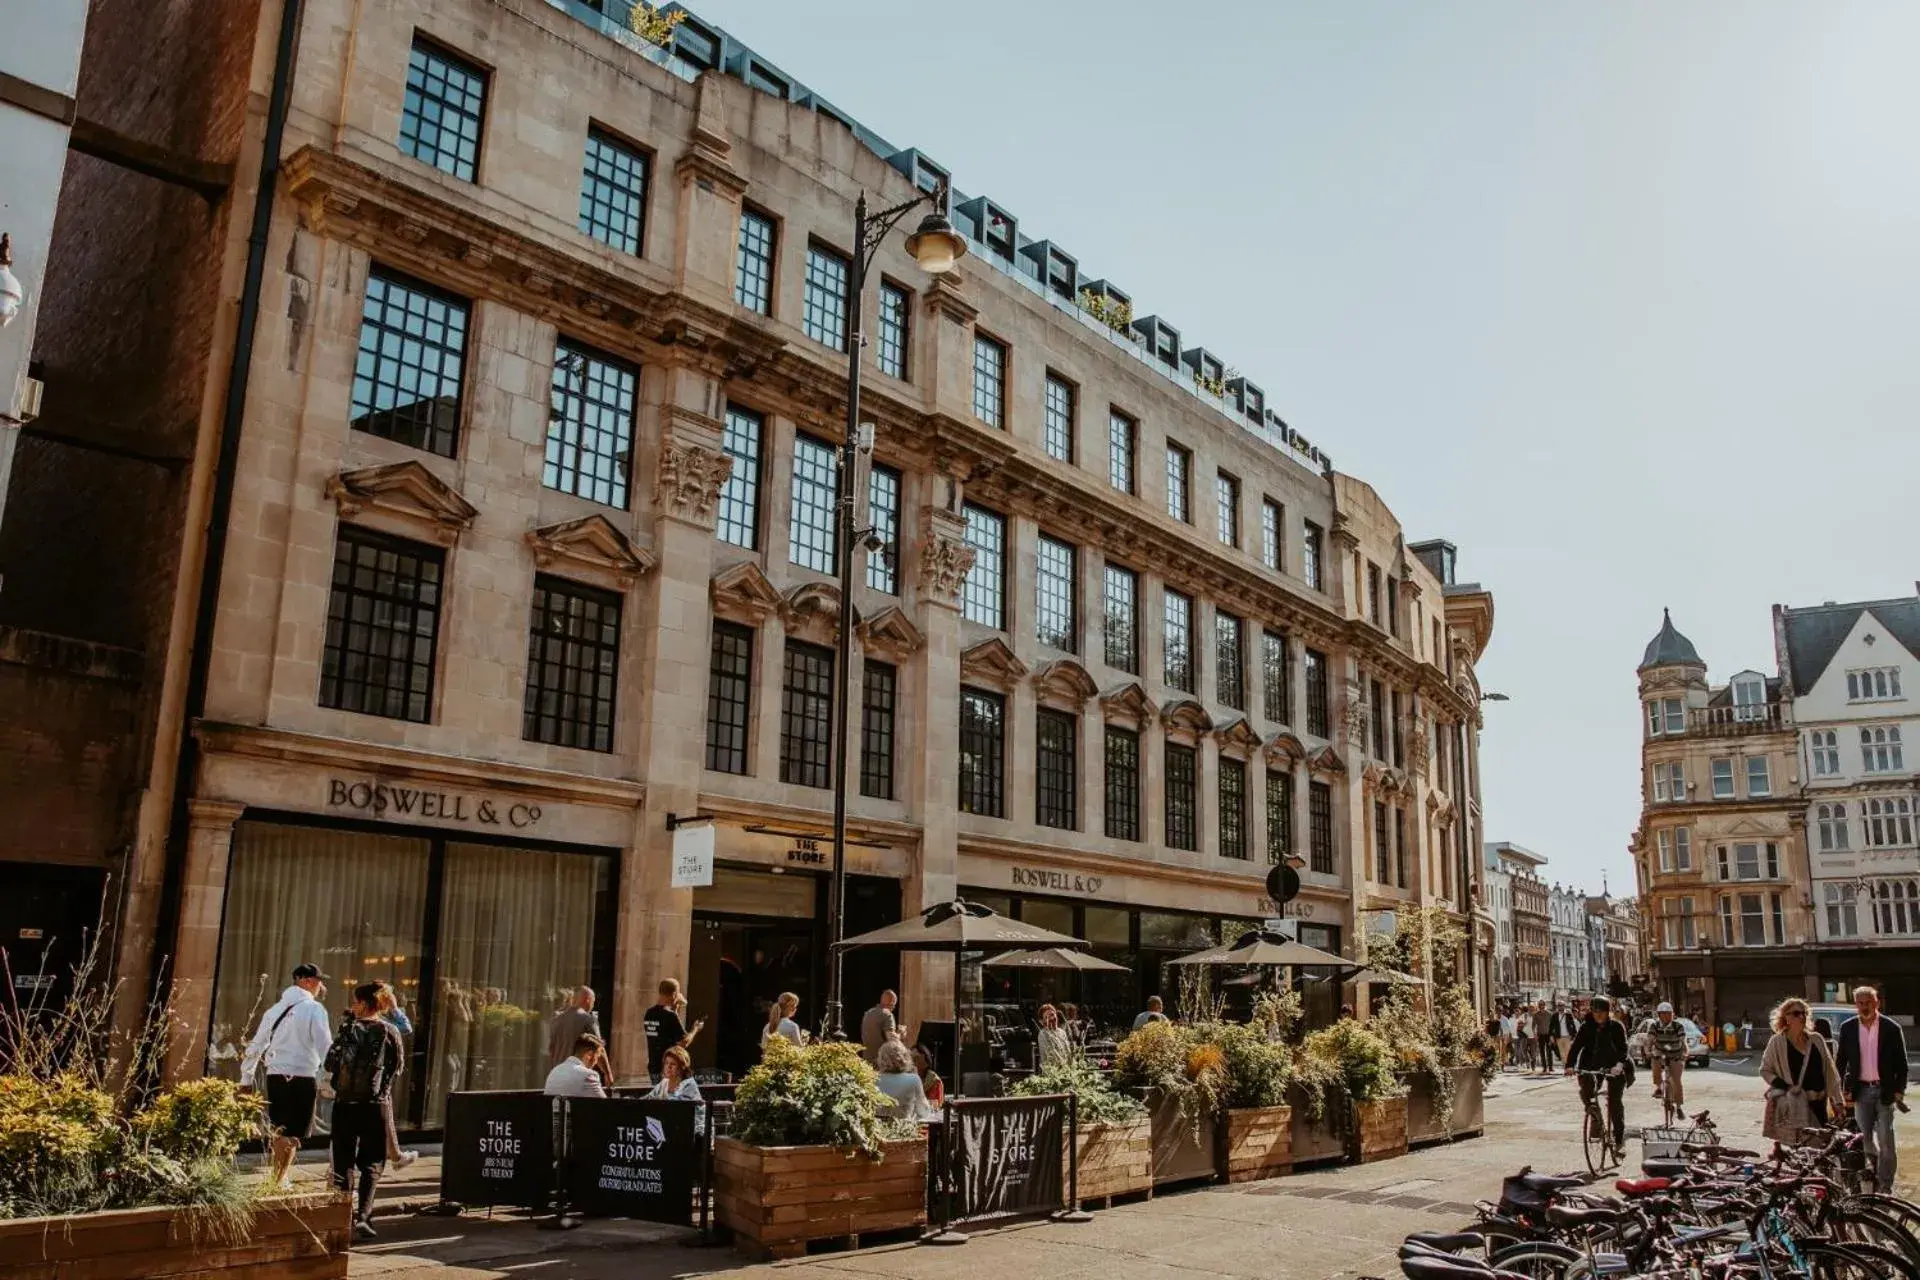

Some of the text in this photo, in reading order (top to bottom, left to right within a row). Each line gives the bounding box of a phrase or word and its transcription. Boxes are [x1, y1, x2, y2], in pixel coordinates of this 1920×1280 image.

[329, 779, 470, 821] BOSWELL
[477, 799, 500, 825] &
[794, 839, 819, 851] THE
[787, 850, 827, 864] STORE
[1012, 866, 1073, 891] BOSWELL
[1074, 875, 1085, 892] &
[487, 1120, 512, 1137] THE
[617, 1126, 644, 1143] THE
[1000, 1127, 1027, 1144] THE
[479, 1138, 521, 1156] STORE
[608, 1143, 655, 1162] STORE
[991, 1145, 1036, 1165] STORE
[601, 1164, 662, 1181] CONGRATULATIONS
[621, 1180, 663, 1194] GRADUATES
